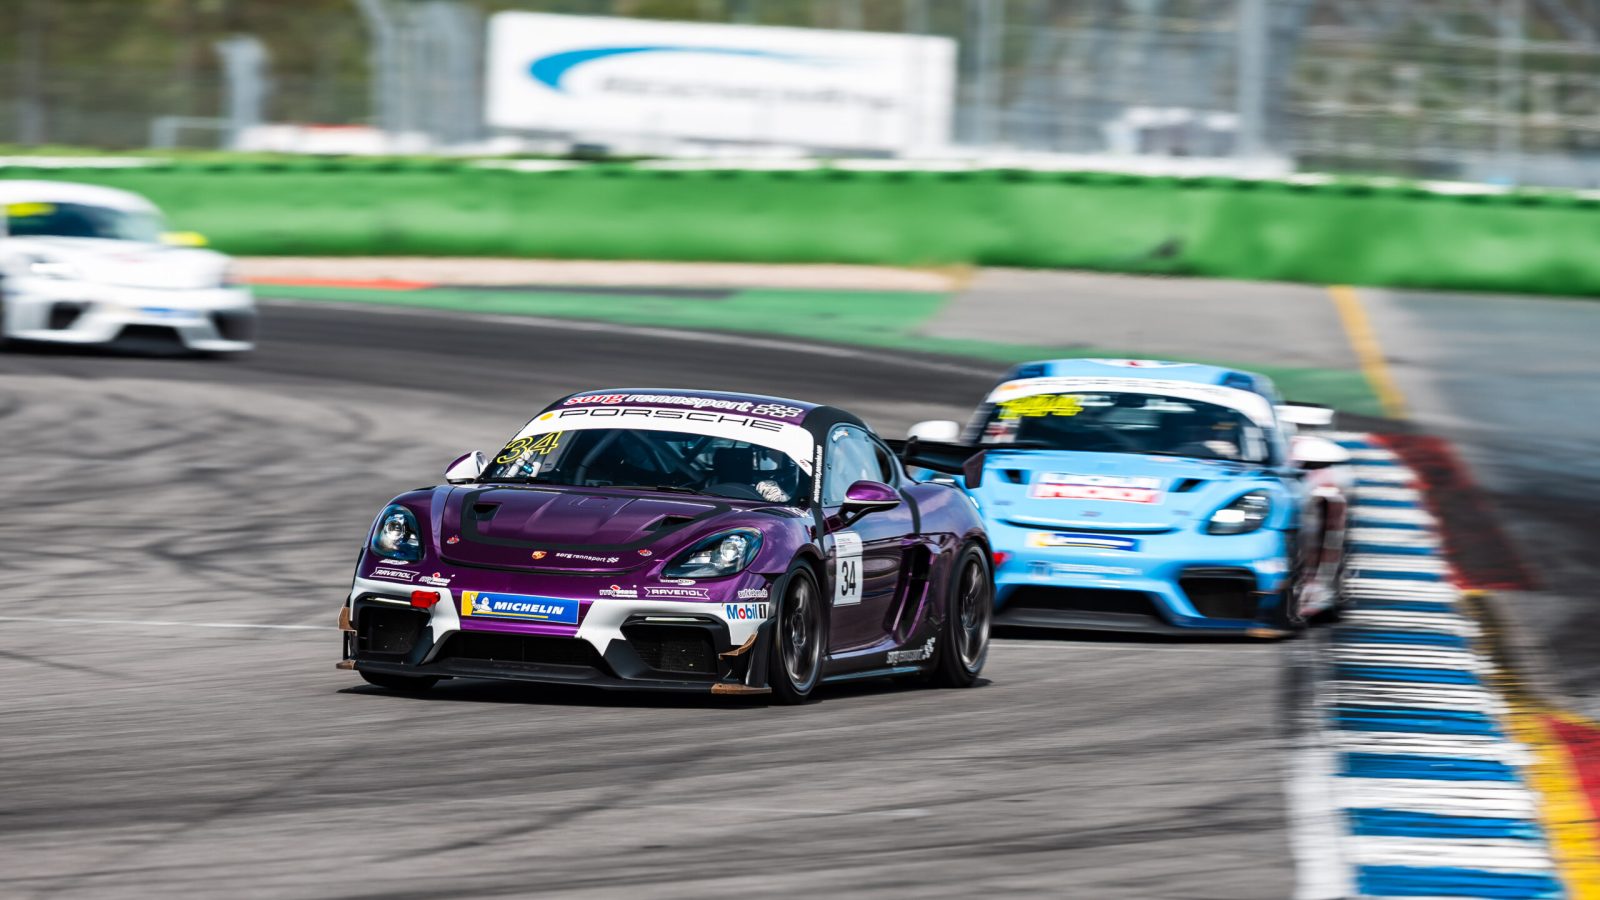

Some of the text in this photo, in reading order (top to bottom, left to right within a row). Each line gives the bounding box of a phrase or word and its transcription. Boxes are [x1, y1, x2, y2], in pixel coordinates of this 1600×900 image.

[563, 394, 755, 413] sorg rennsport
[559, 408, 784, 433] PORSCHE
[496, 430, 564, 464] 34
[375, 569, 411, 579] RAVENOL
[841, 560, 857, 596] 34
[651, 588, 703, 597] RAVENOL
[493, 601, 565, 615] MICHELIN
[726, 603, 766, 620] Mobil 1
